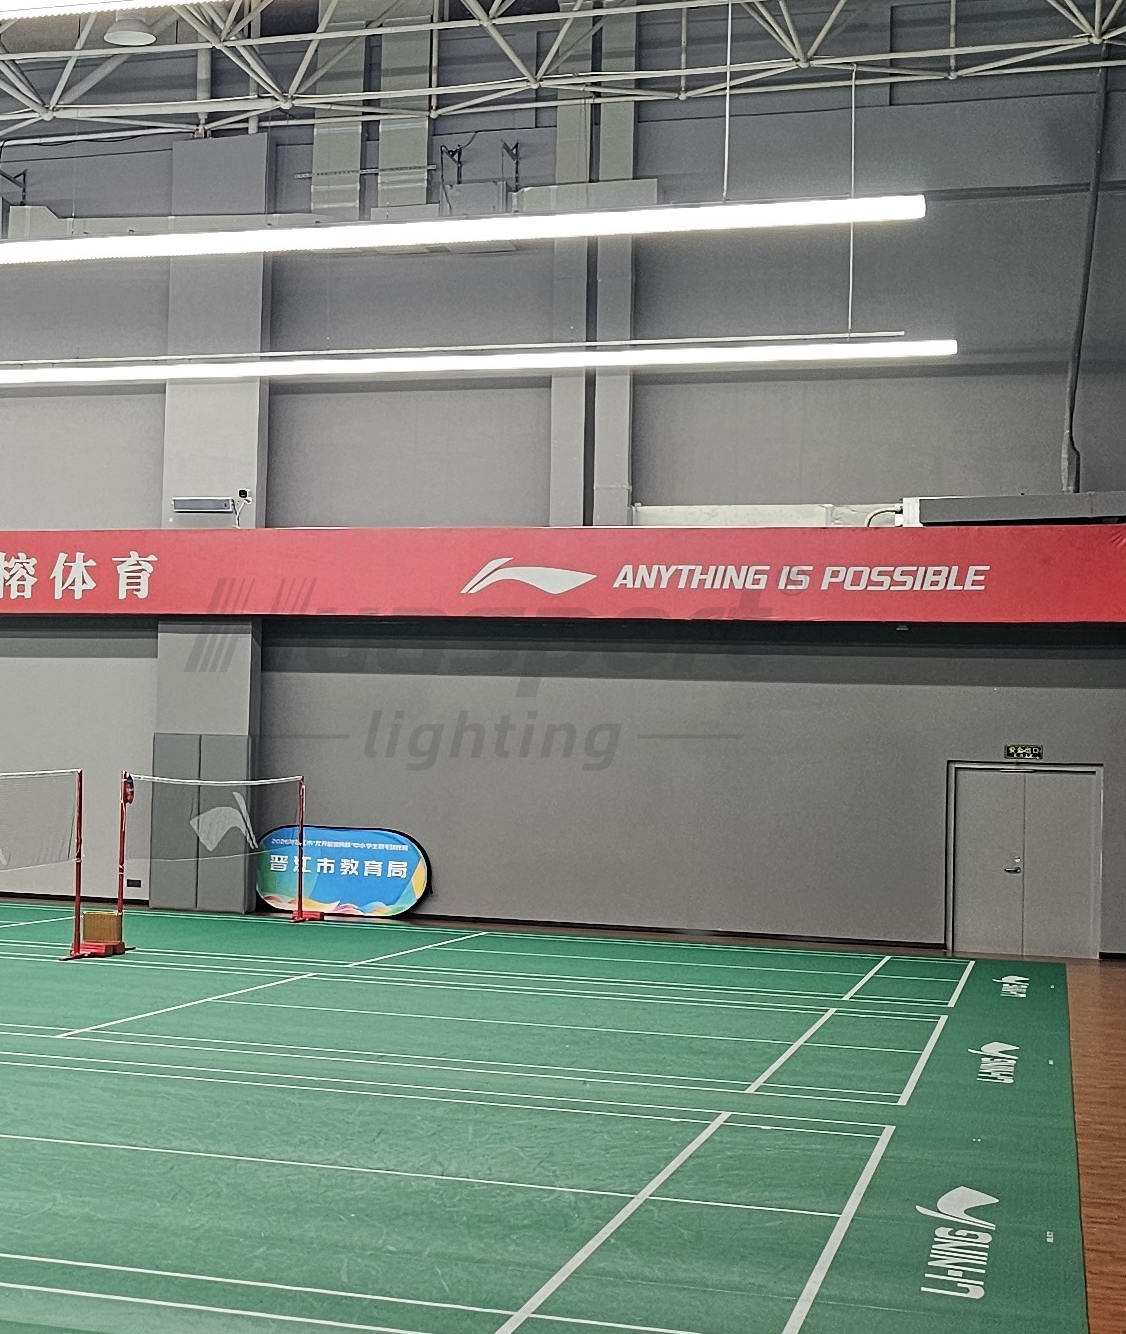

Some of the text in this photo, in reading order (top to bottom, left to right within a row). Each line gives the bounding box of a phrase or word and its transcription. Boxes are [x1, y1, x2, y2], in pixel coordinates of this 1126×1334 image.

[612, 564, 991, 591] ANYTHING IS POSSIBLE
[269, 854, 409, 878] 晋江市教育局
[920, 1226, 993, 1300] LI-NING
